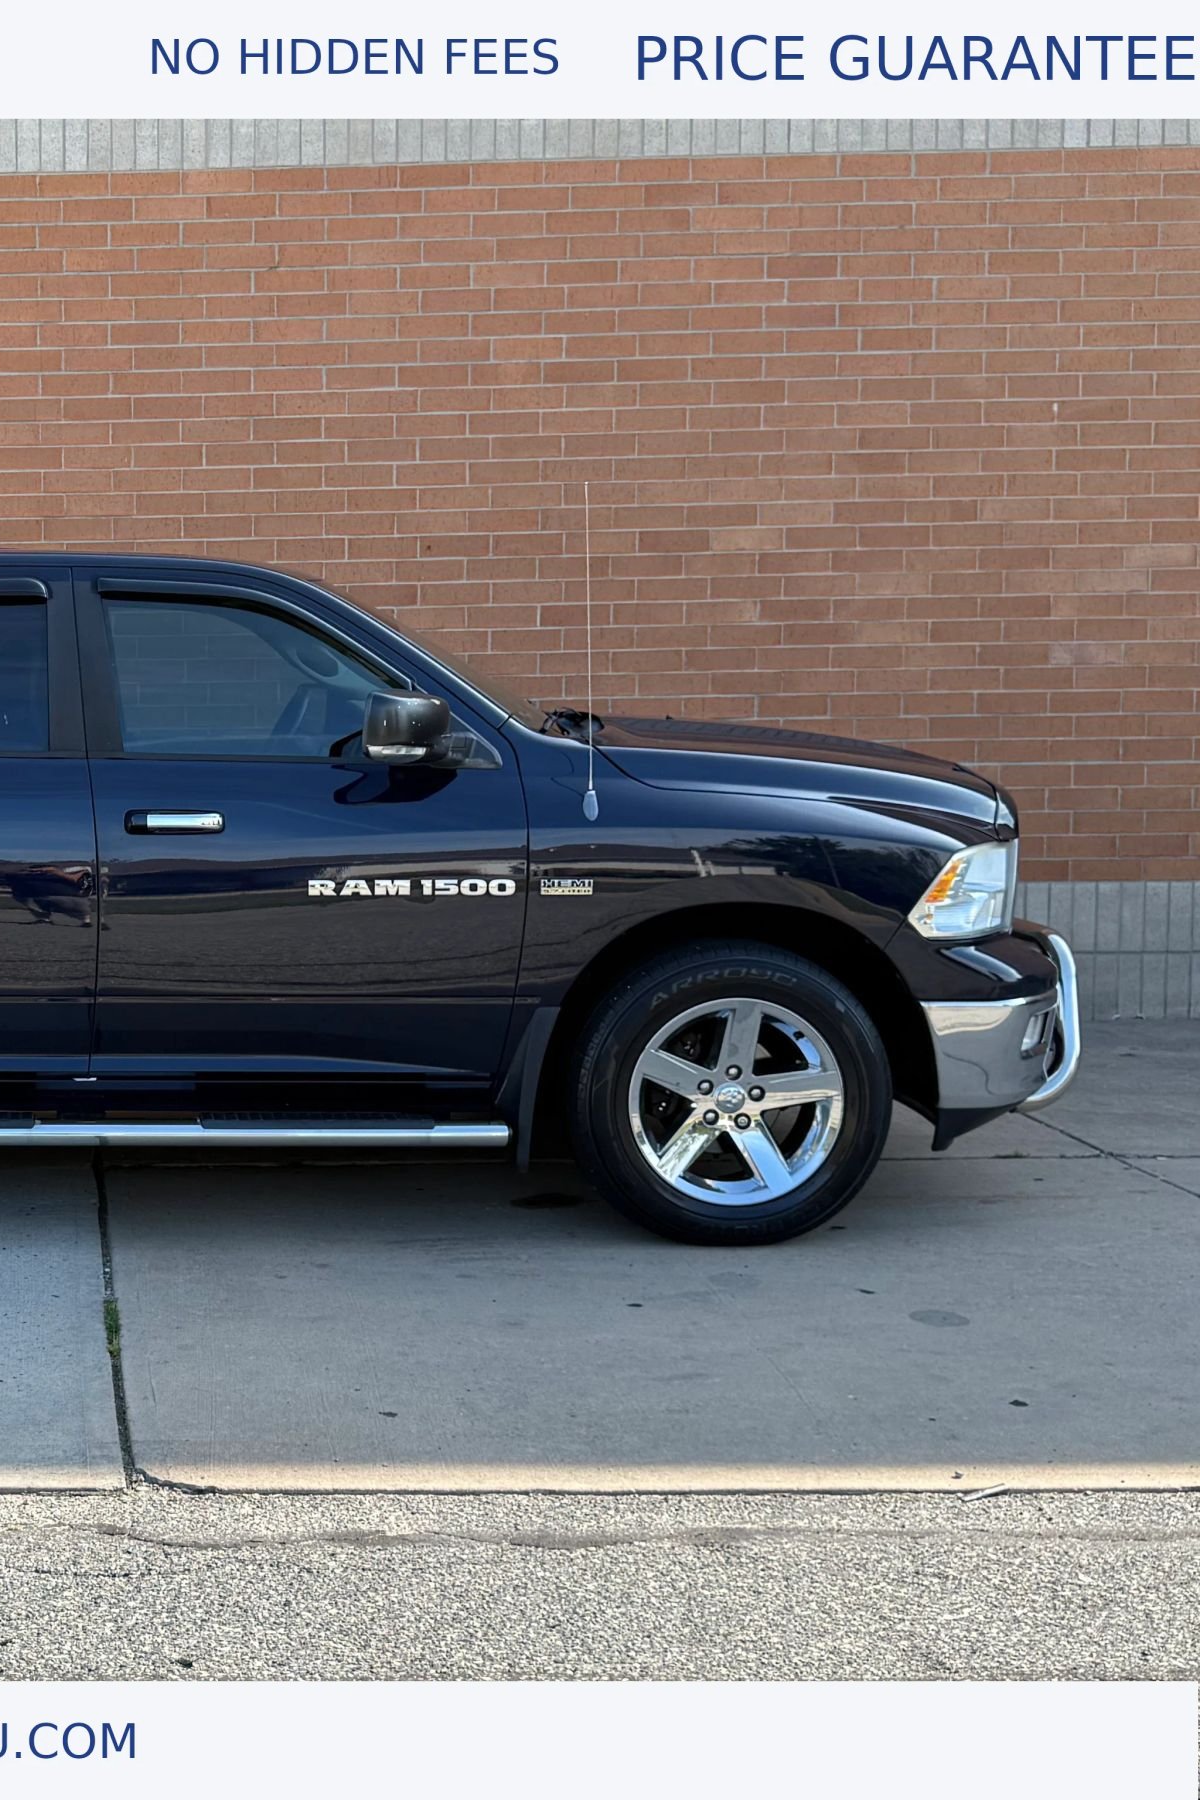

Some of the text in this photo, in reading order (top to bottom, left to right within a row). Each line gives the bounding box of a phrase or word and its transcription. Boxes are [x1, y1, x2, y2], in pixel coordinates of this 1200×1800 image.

[307, 879, 517, 896] RAM 1500
[542, 879, 592, 888] HEMI
